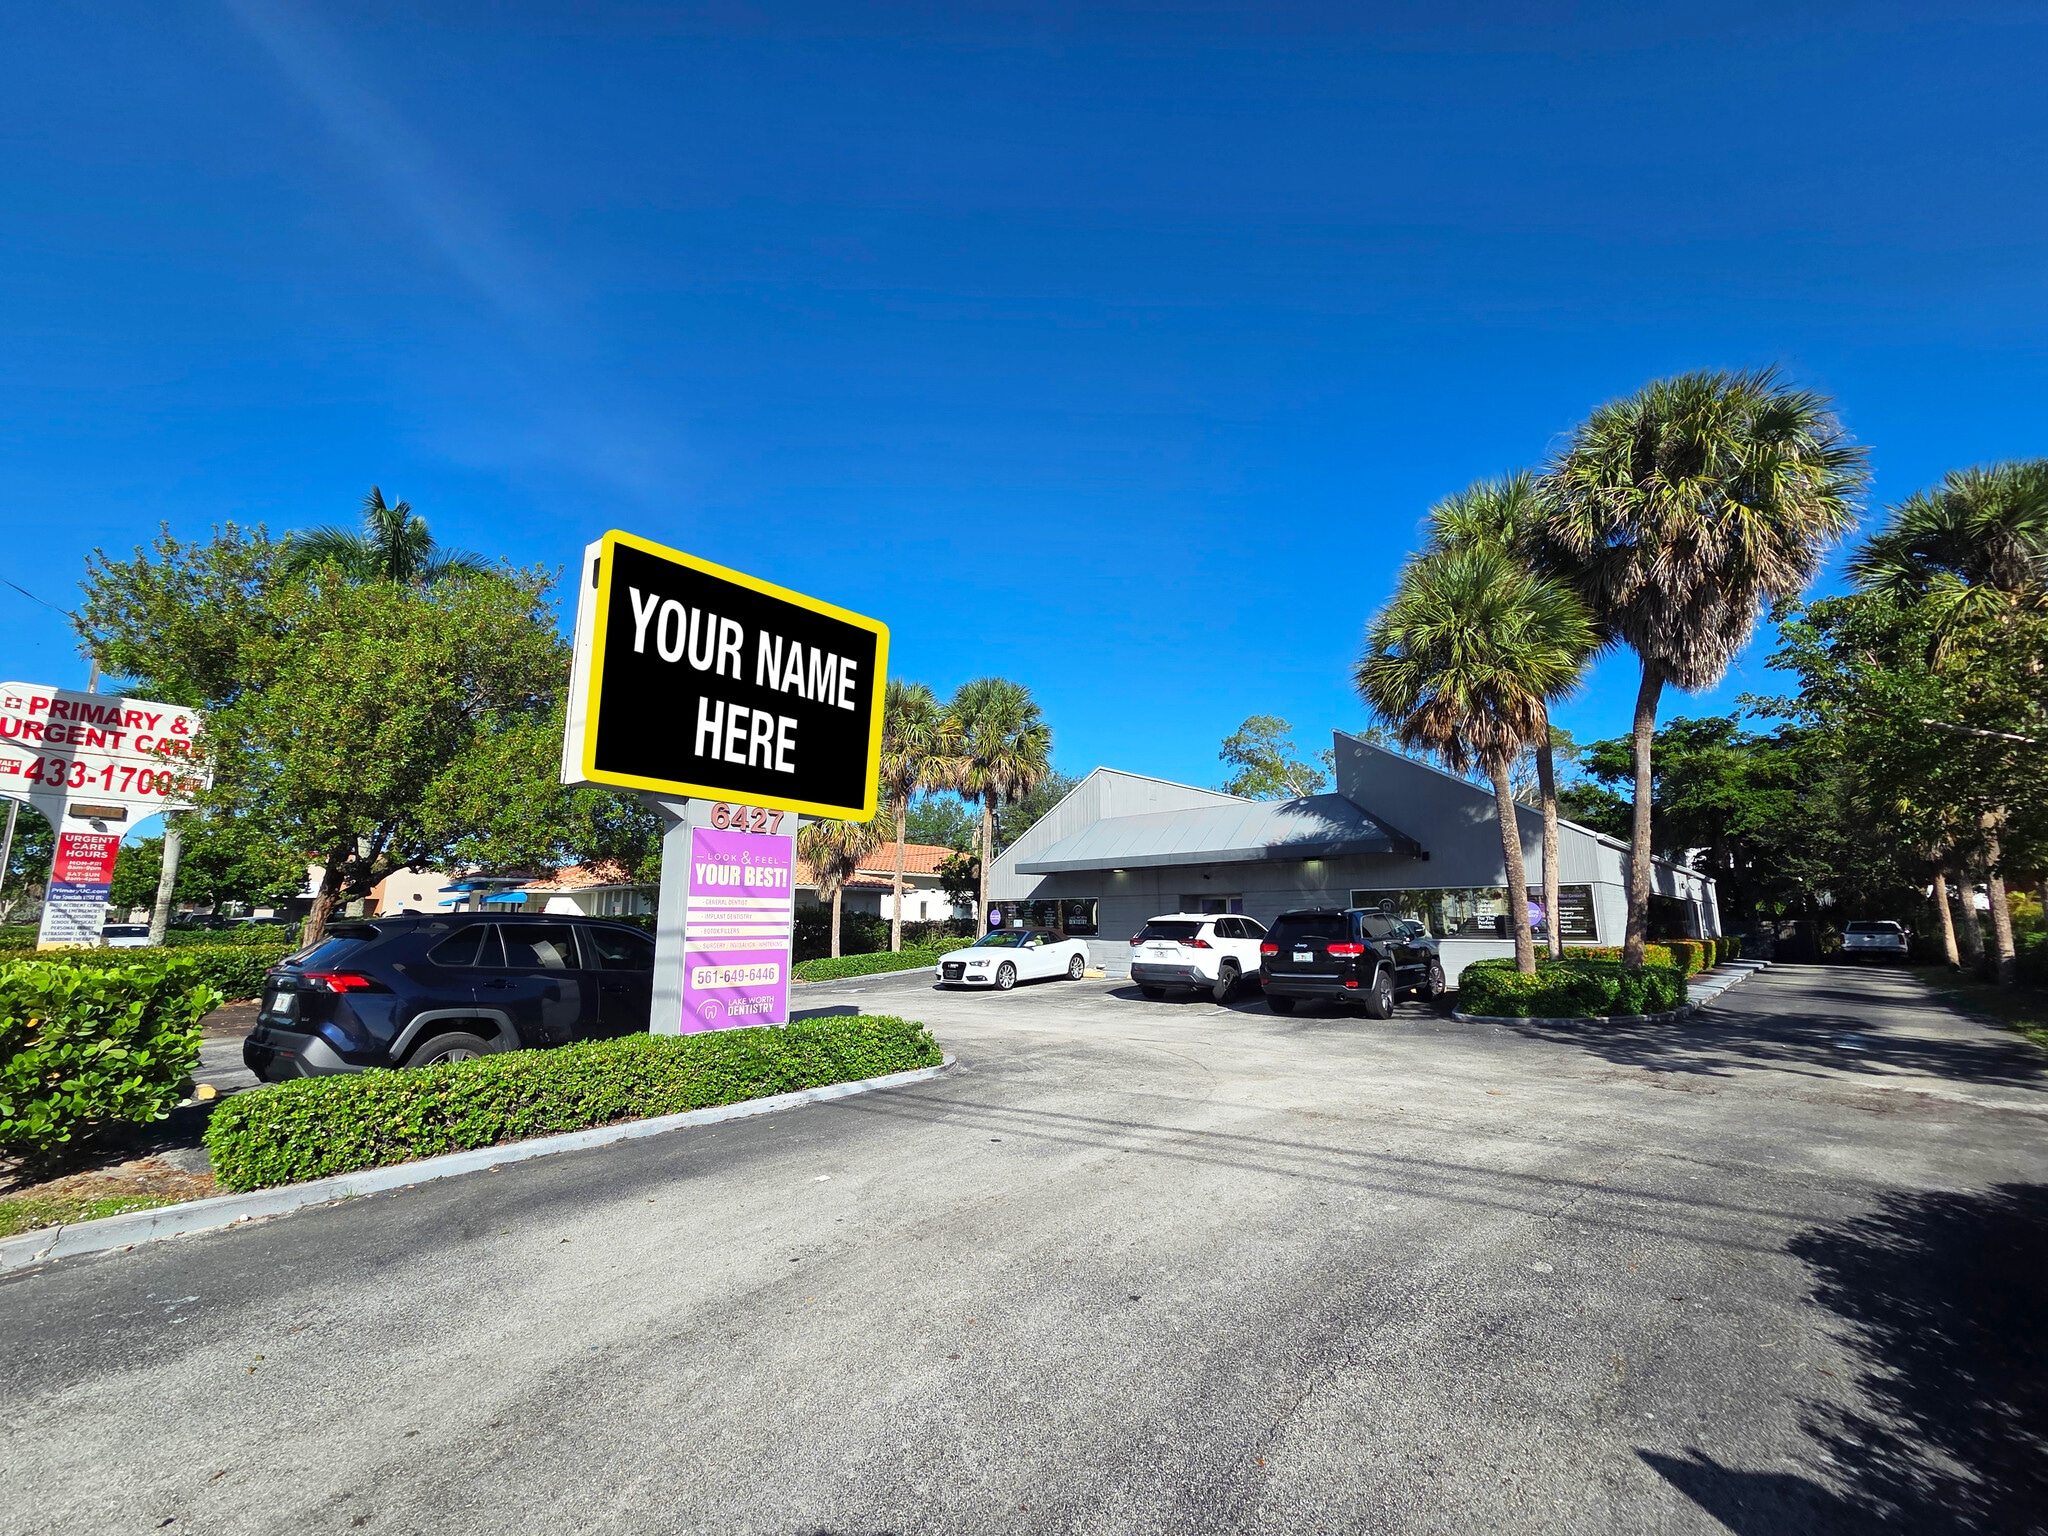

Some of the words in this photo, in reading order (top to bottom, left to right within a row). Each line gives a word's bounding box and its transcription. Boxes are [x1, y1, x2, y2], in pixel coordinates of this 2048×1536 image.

[628, 586, 744, 680] YOUR
[756, 630, 858, 711] NAME
[28, 696, 163, 731] PRIMARY
[170, 717, 189, 735] &
[0, 716, 127, 750] URGENT
[694, 696, 798, 774] HERE
[23, 757, 173, 797] 433-1700
[711, 802, 785, 835] 6427
[65, 834, 116, 844] URGENT
[72, 843, 105, 851] CARE
[65, 850, 109, 859] HOURS
[708, 853, 737, 861] LOOK
[740, 850, 751, 865] &
[755, 856, 779, 865] FEEL
[695, 863, 741, 886] YOUR
[744, 866, 788, 888] BEST!
[697, 967, 775, 985] 561-649-6446
[727, 997, 747, 1006] LAKE
[748, 996, 775, 1004] WORTH
[728, 1002, 774, 1017] DENTISTRY
